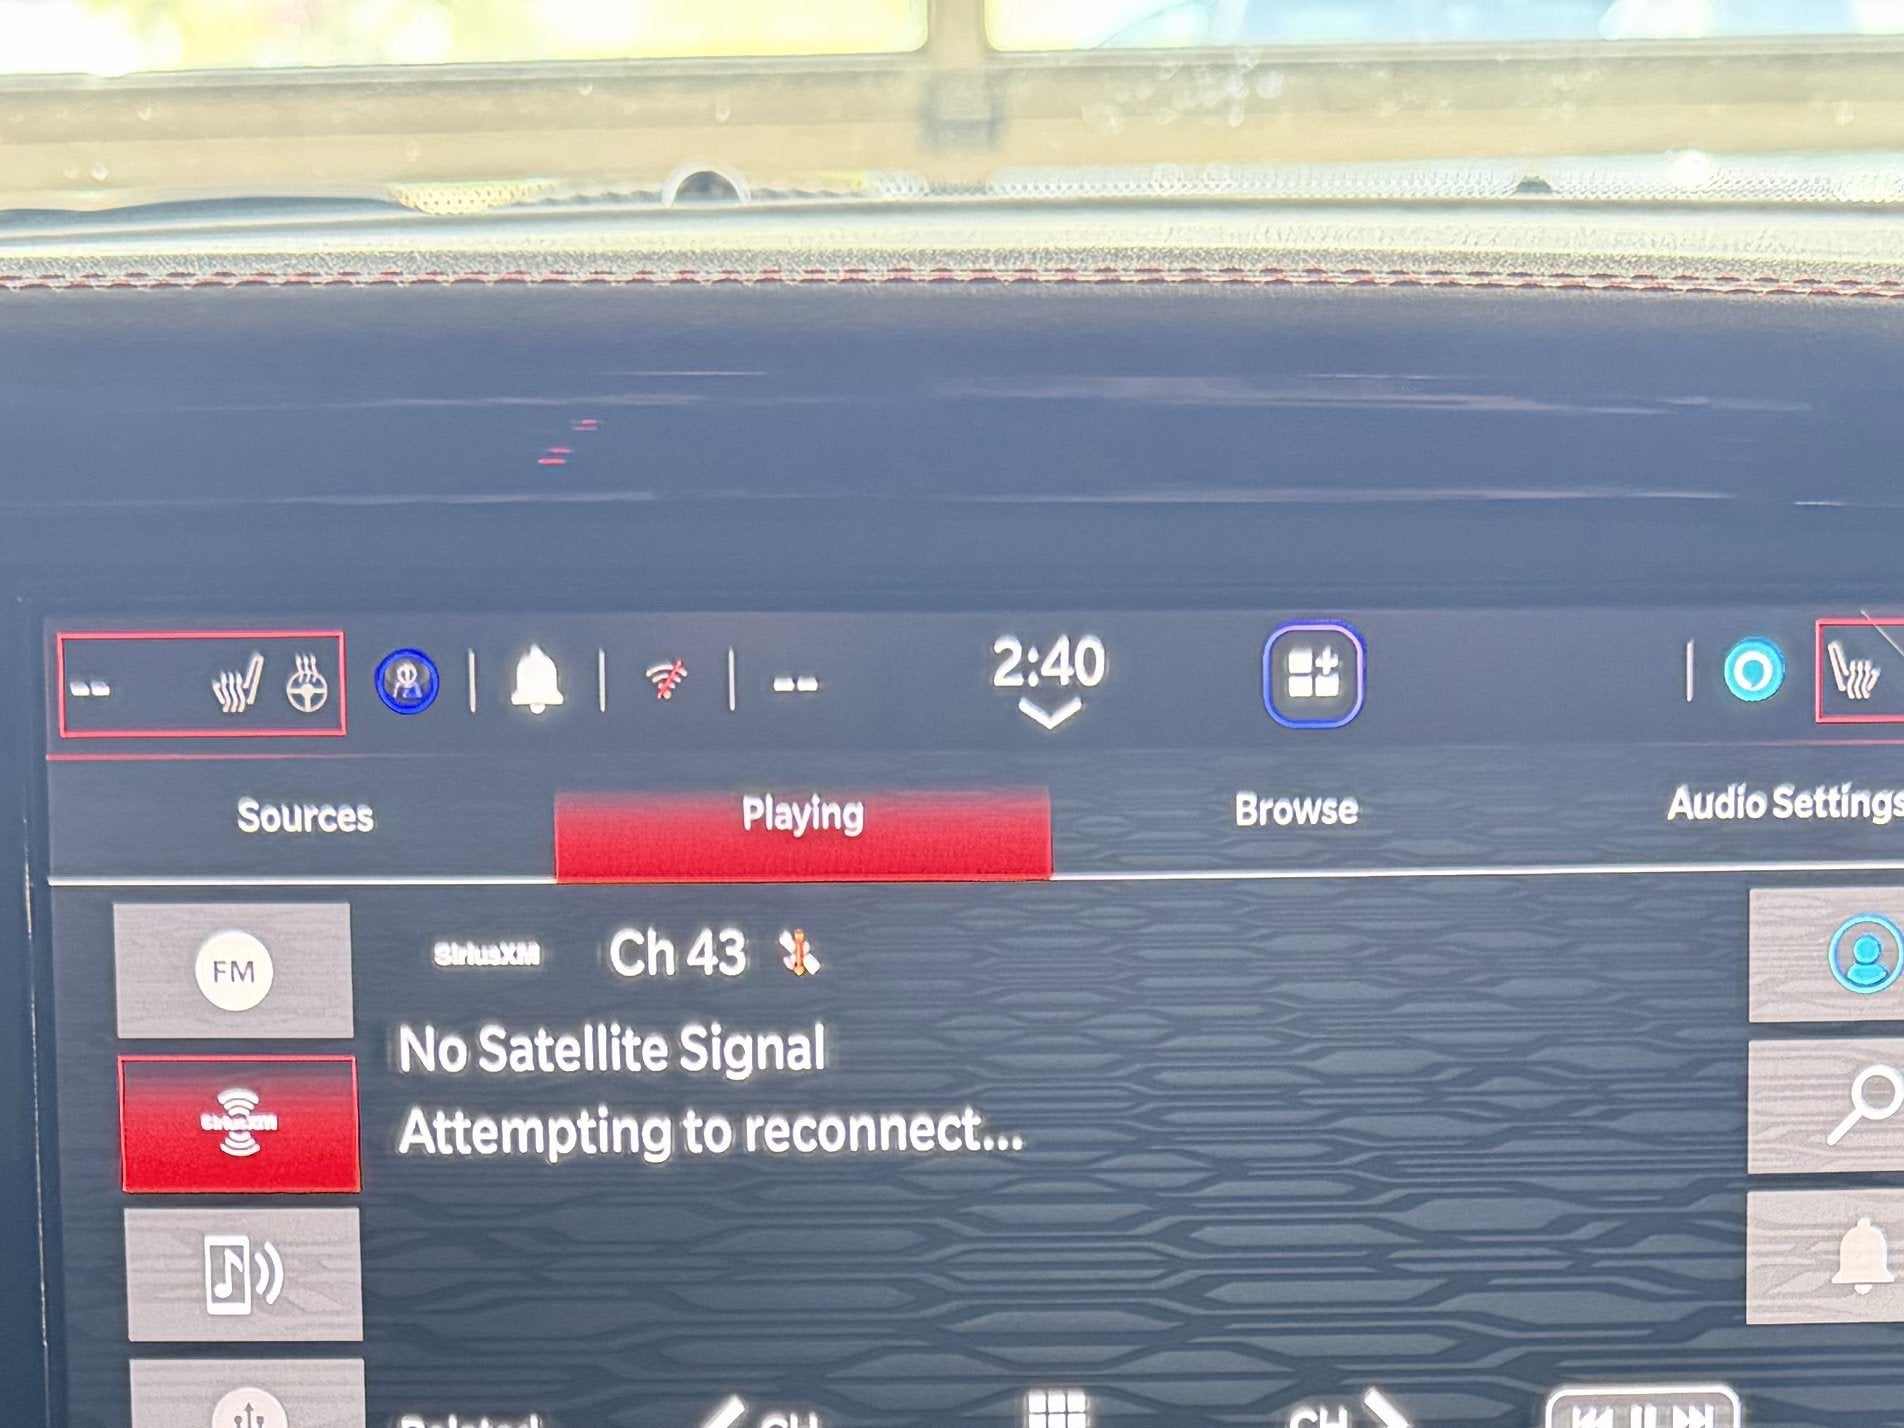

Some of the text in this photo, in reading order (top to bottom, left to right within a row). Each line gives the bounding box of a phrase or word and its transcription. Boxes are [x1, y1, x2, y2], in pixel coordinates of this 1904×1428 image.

[992, 636, 1106, 689] 2:40
[237, 799, 374, 834] Sources
[742, 796, 865, 838] Playing
[1235, 792, 1359, 827] Browse
[1667, 784, 1767, 823] Audio
[211, 959, 255, 983] FM
[609, 928, 746, 976] Ch 43
[398, 1023, 826, 1081] No Satellite Signal
[398, 1107, 1024, 1164] Attempting to reconnect...
